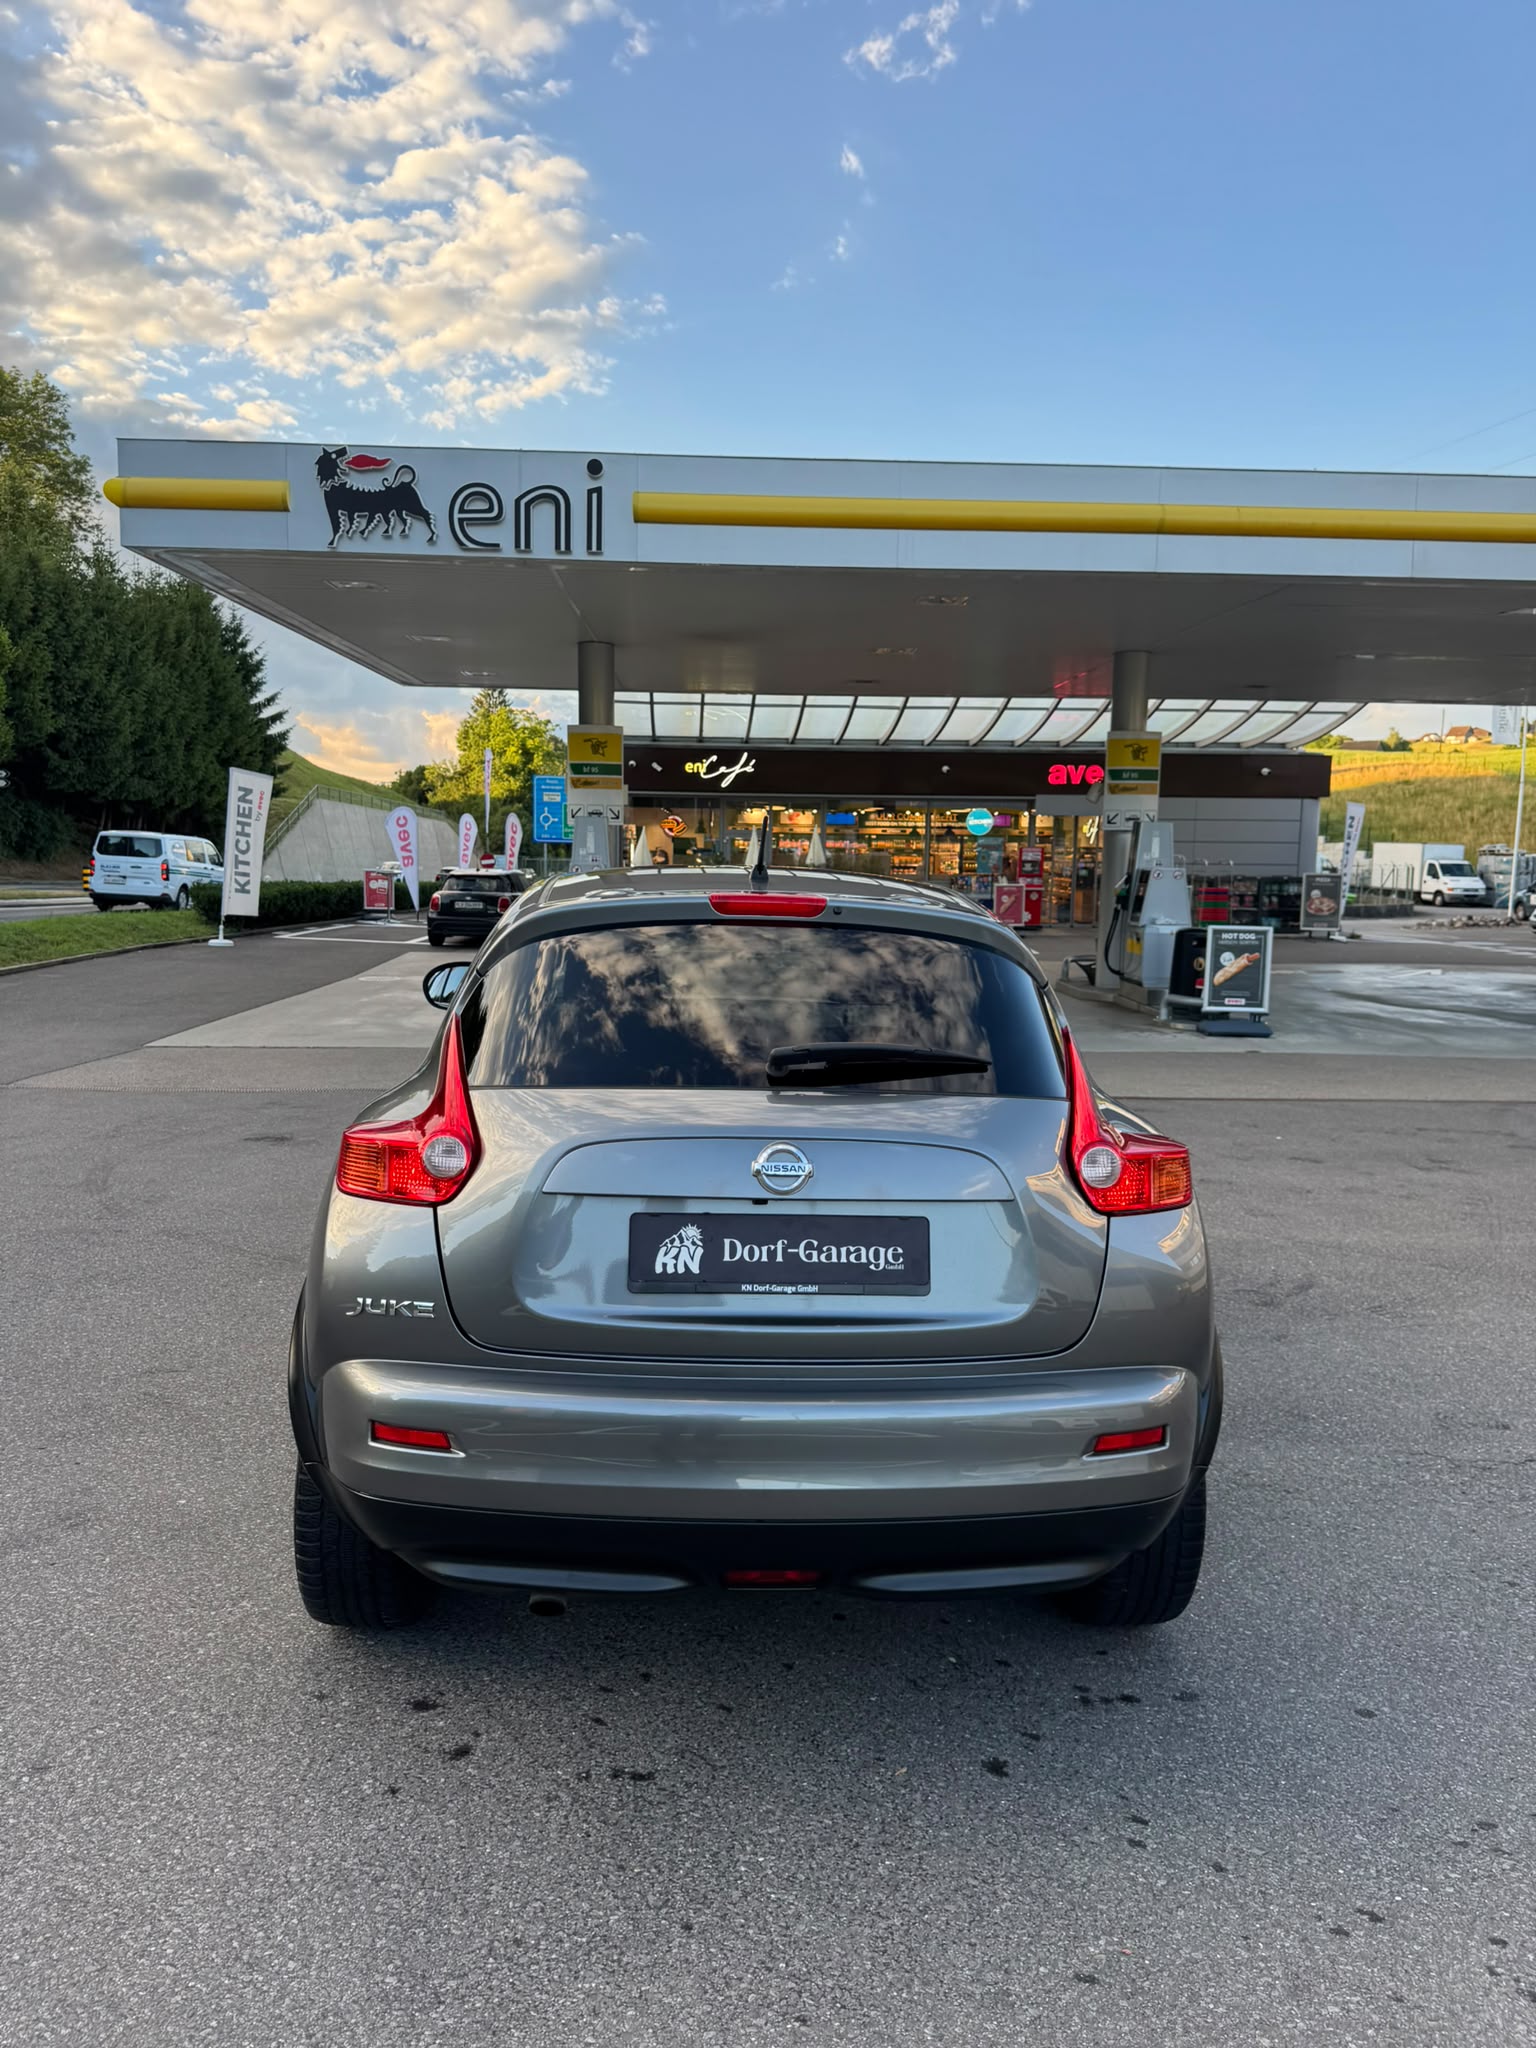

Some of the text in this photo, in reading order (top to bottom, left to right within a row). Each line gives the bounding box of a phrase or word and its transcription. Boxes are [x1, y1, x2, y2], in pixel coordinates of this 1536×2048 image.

[449, 458, 604, 555] eni
[684, 759, 707, 774] eni
[1047, 764, 1105, 786] ave
[254, 790, 265, 822] by avec
[234, 786, 254, 894] KITCHEN
[461, 821, 472, 864] avec
[760, 1164, 807, 1174] NISSAN
[654, 1238, 904, 1275] KN Dorf-Garage
[741, 1284, 819, 1294] KN Dorf-Garage GmbH
[345, 1297, 436, 1319] JUKE
